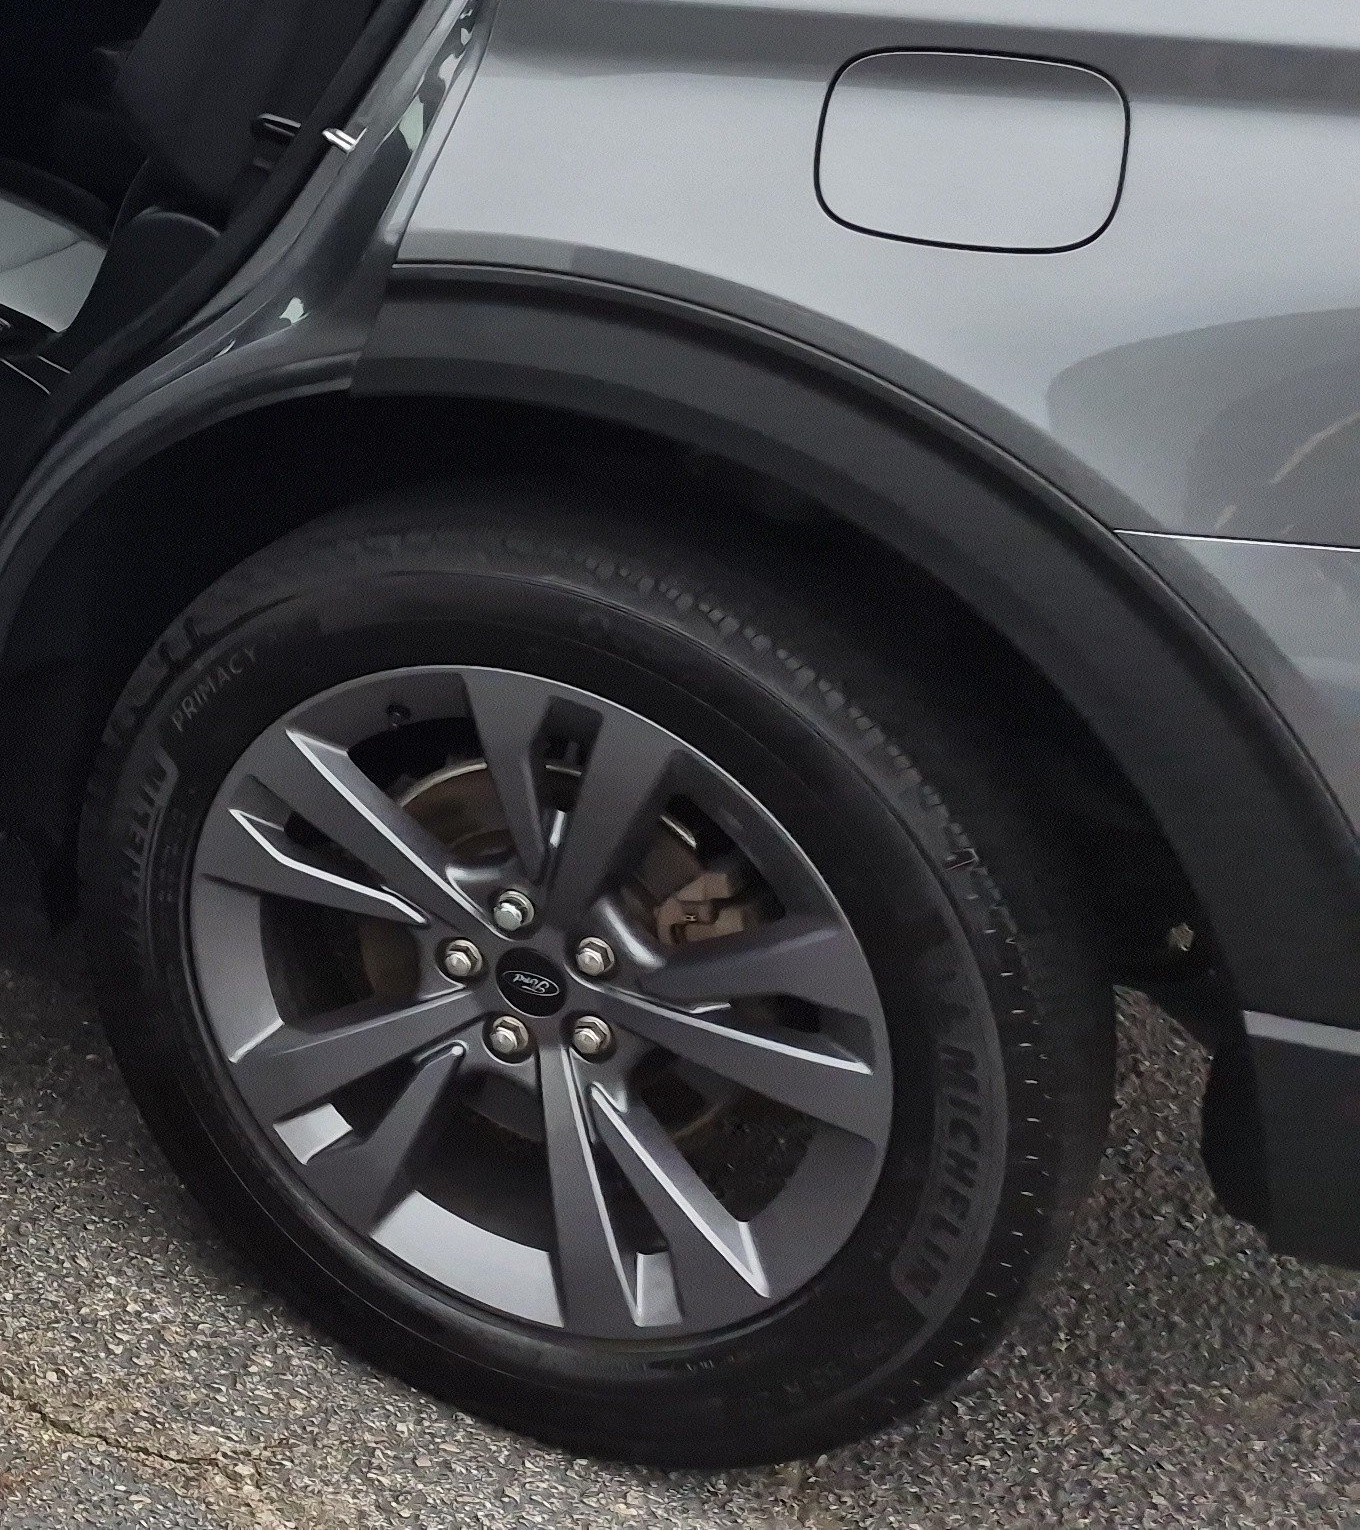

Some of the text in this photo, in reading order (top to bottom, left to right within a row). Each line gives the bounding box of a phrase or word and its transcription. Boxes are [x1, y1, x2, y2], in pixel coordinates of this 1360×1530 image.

[171, 645, 258, 733] PRIMACY
[511, 972, 552, 994] Ford
[899, 1042, 984, 1299] MICHELIN
